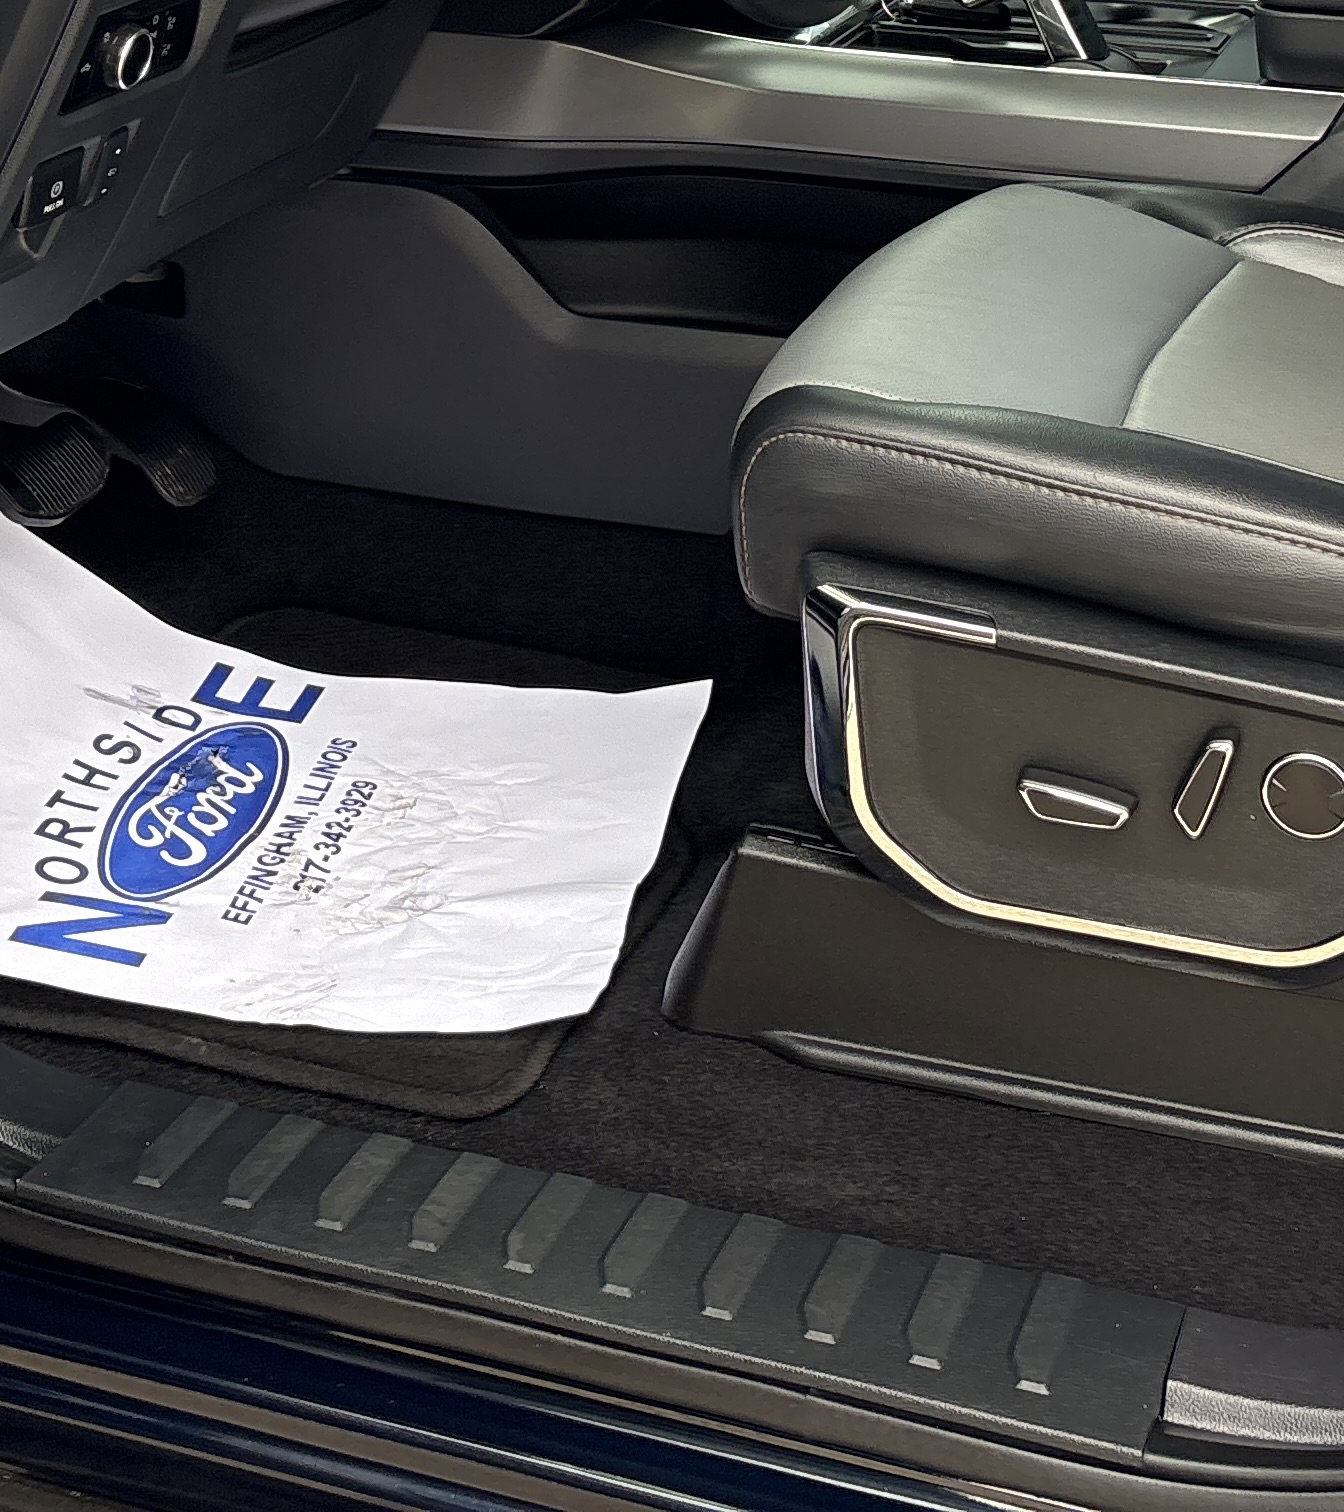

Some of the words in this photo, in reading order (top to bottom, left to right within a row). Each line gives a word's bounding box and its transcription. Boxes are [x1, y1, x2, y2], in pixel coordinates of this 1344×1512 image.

[7, 661, 326, 968] NORTHSIDE
[128, 752, 264, 867] Ford
[220, 810, 320, 925] EFFINGHAM,
[294, 737, 358, 806] ILLINOIS
